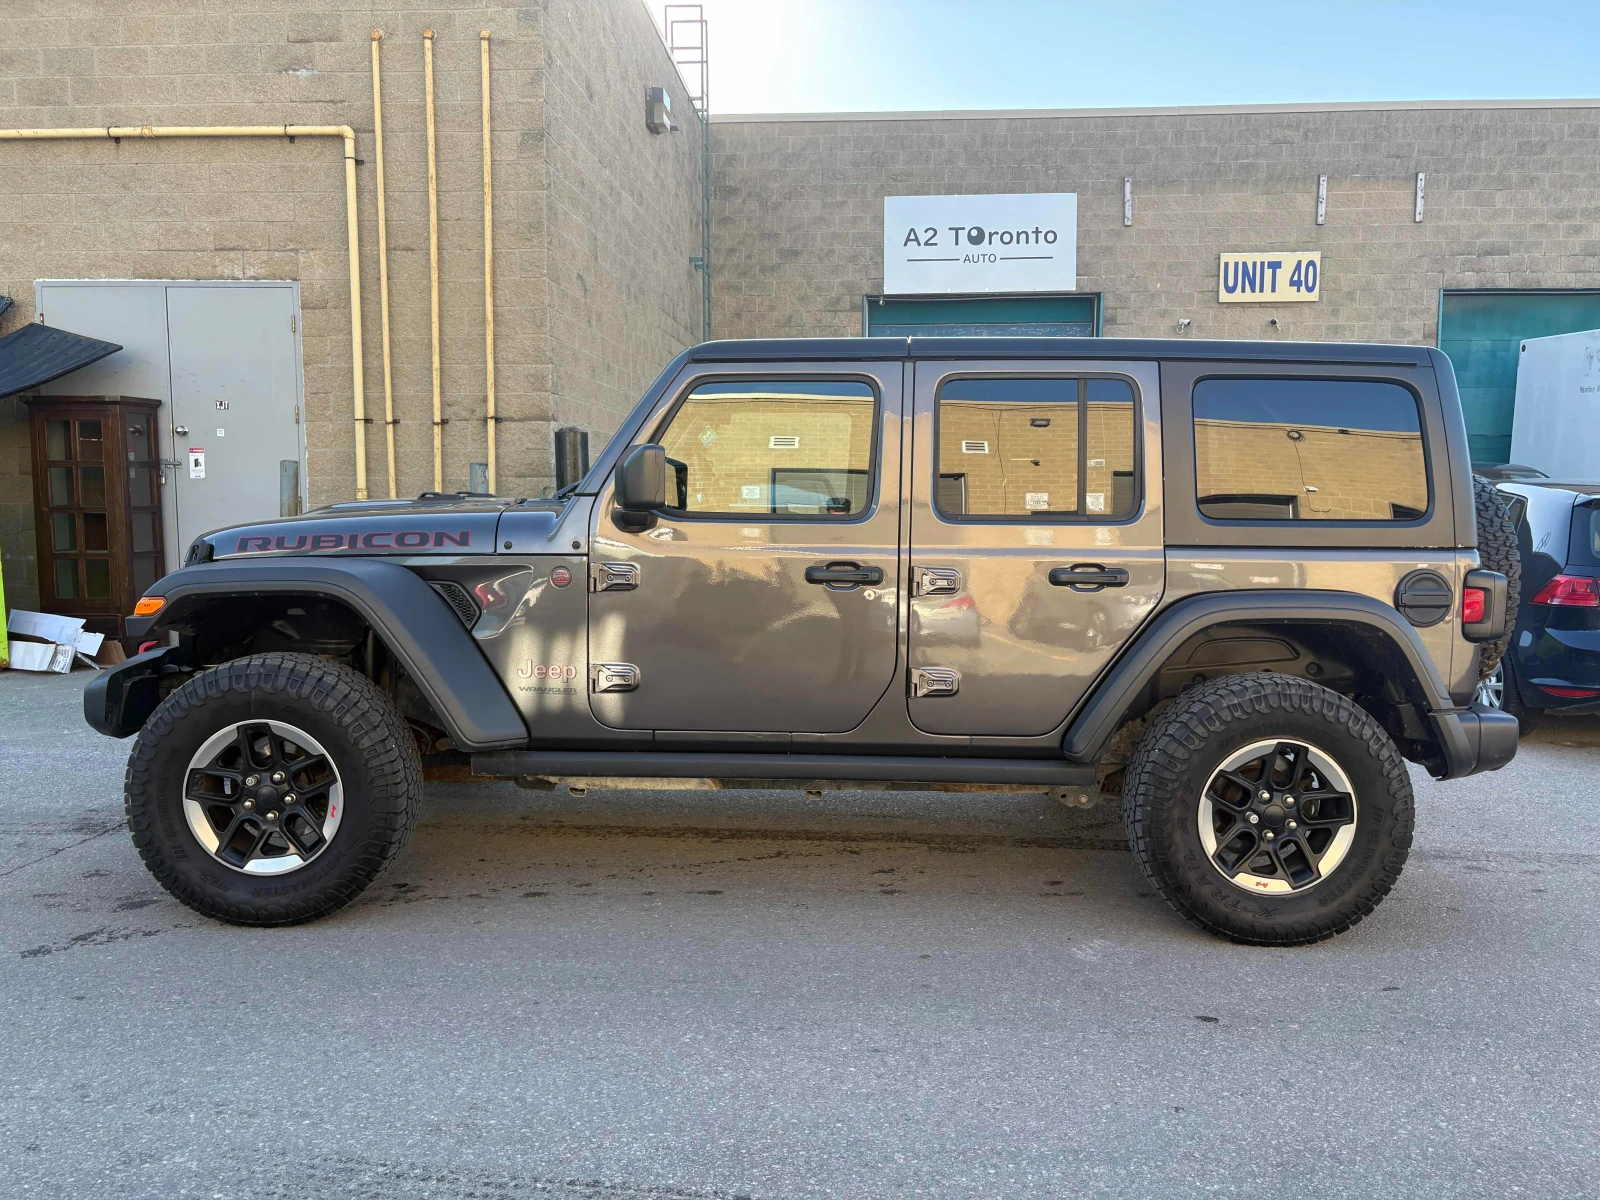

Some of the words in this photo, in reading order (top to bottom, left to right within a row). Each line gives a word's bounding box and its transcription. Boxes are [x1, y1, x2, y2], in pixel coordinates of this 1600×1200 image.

[903, 227, 939, 247] A2
[963, 253, 997, 264] AUTO
[1223, 261, 1281, 294] UNIT
[1288, 259, 1318, 293] 40
[236, 530, 471, 553] RUBICON
[517, 659, 577, 683] Jeep
